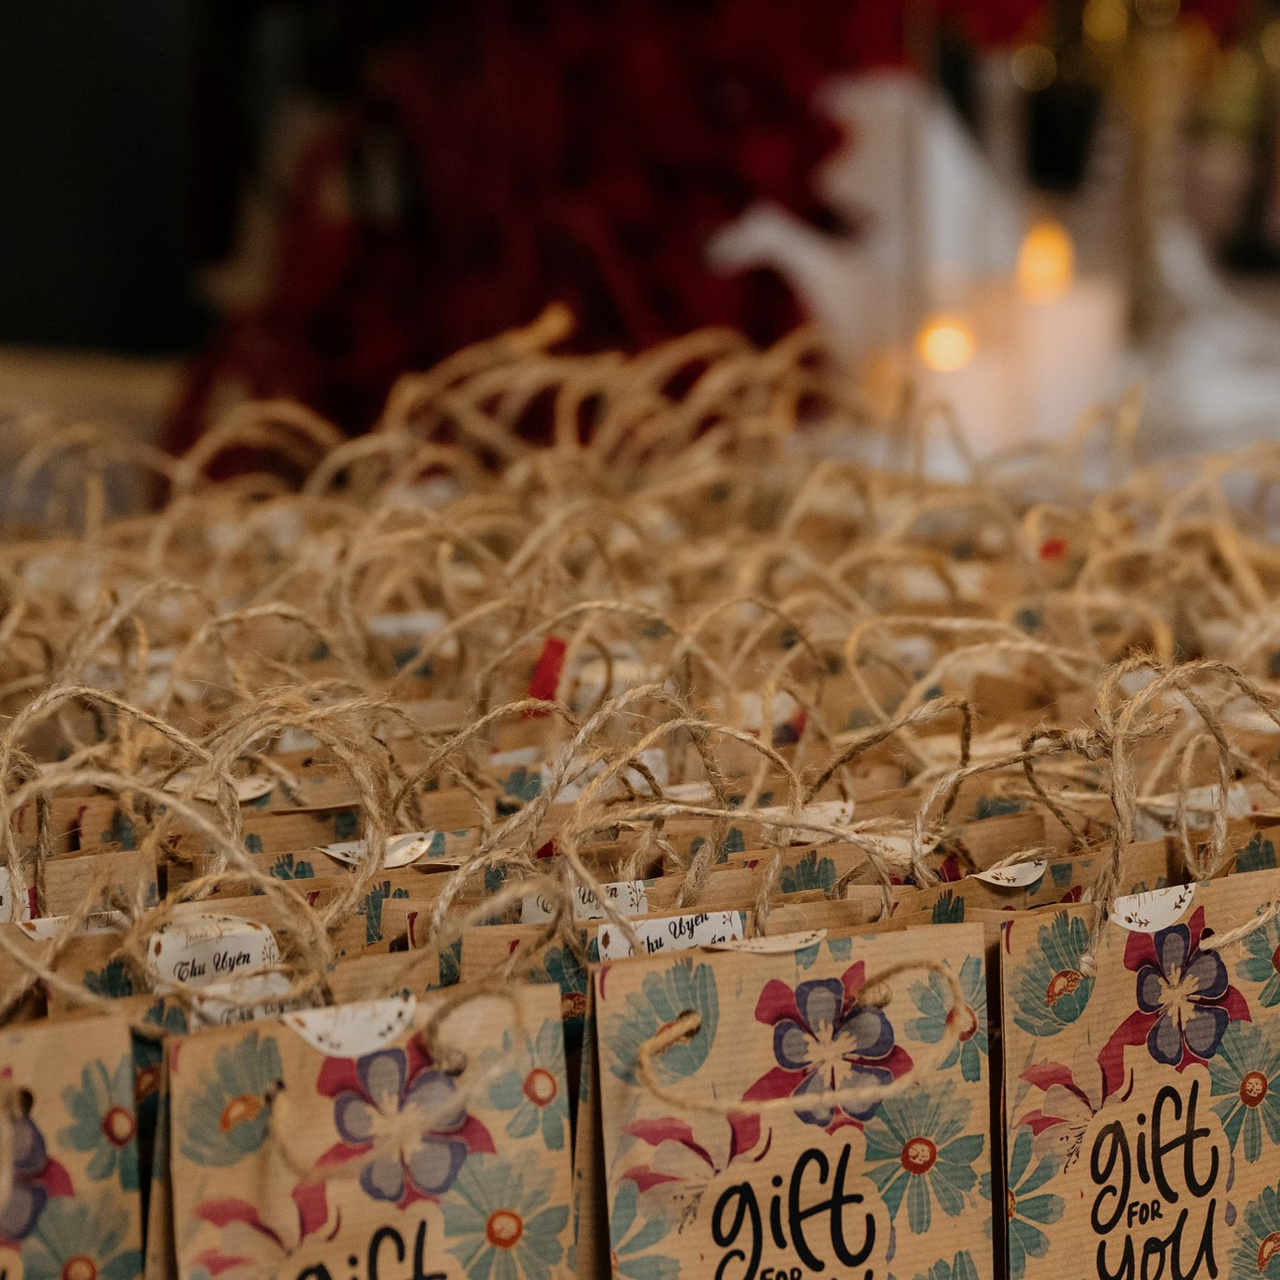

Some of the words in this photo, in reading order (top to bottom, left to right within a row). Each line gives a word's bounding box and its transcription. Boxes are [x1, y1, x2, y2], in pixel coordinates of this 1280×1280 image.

[173, 957, 207, 982] Thu
[1088, 1079, 1219, 1236] gift
[1127, 1198, 1163, 1224] FOR
